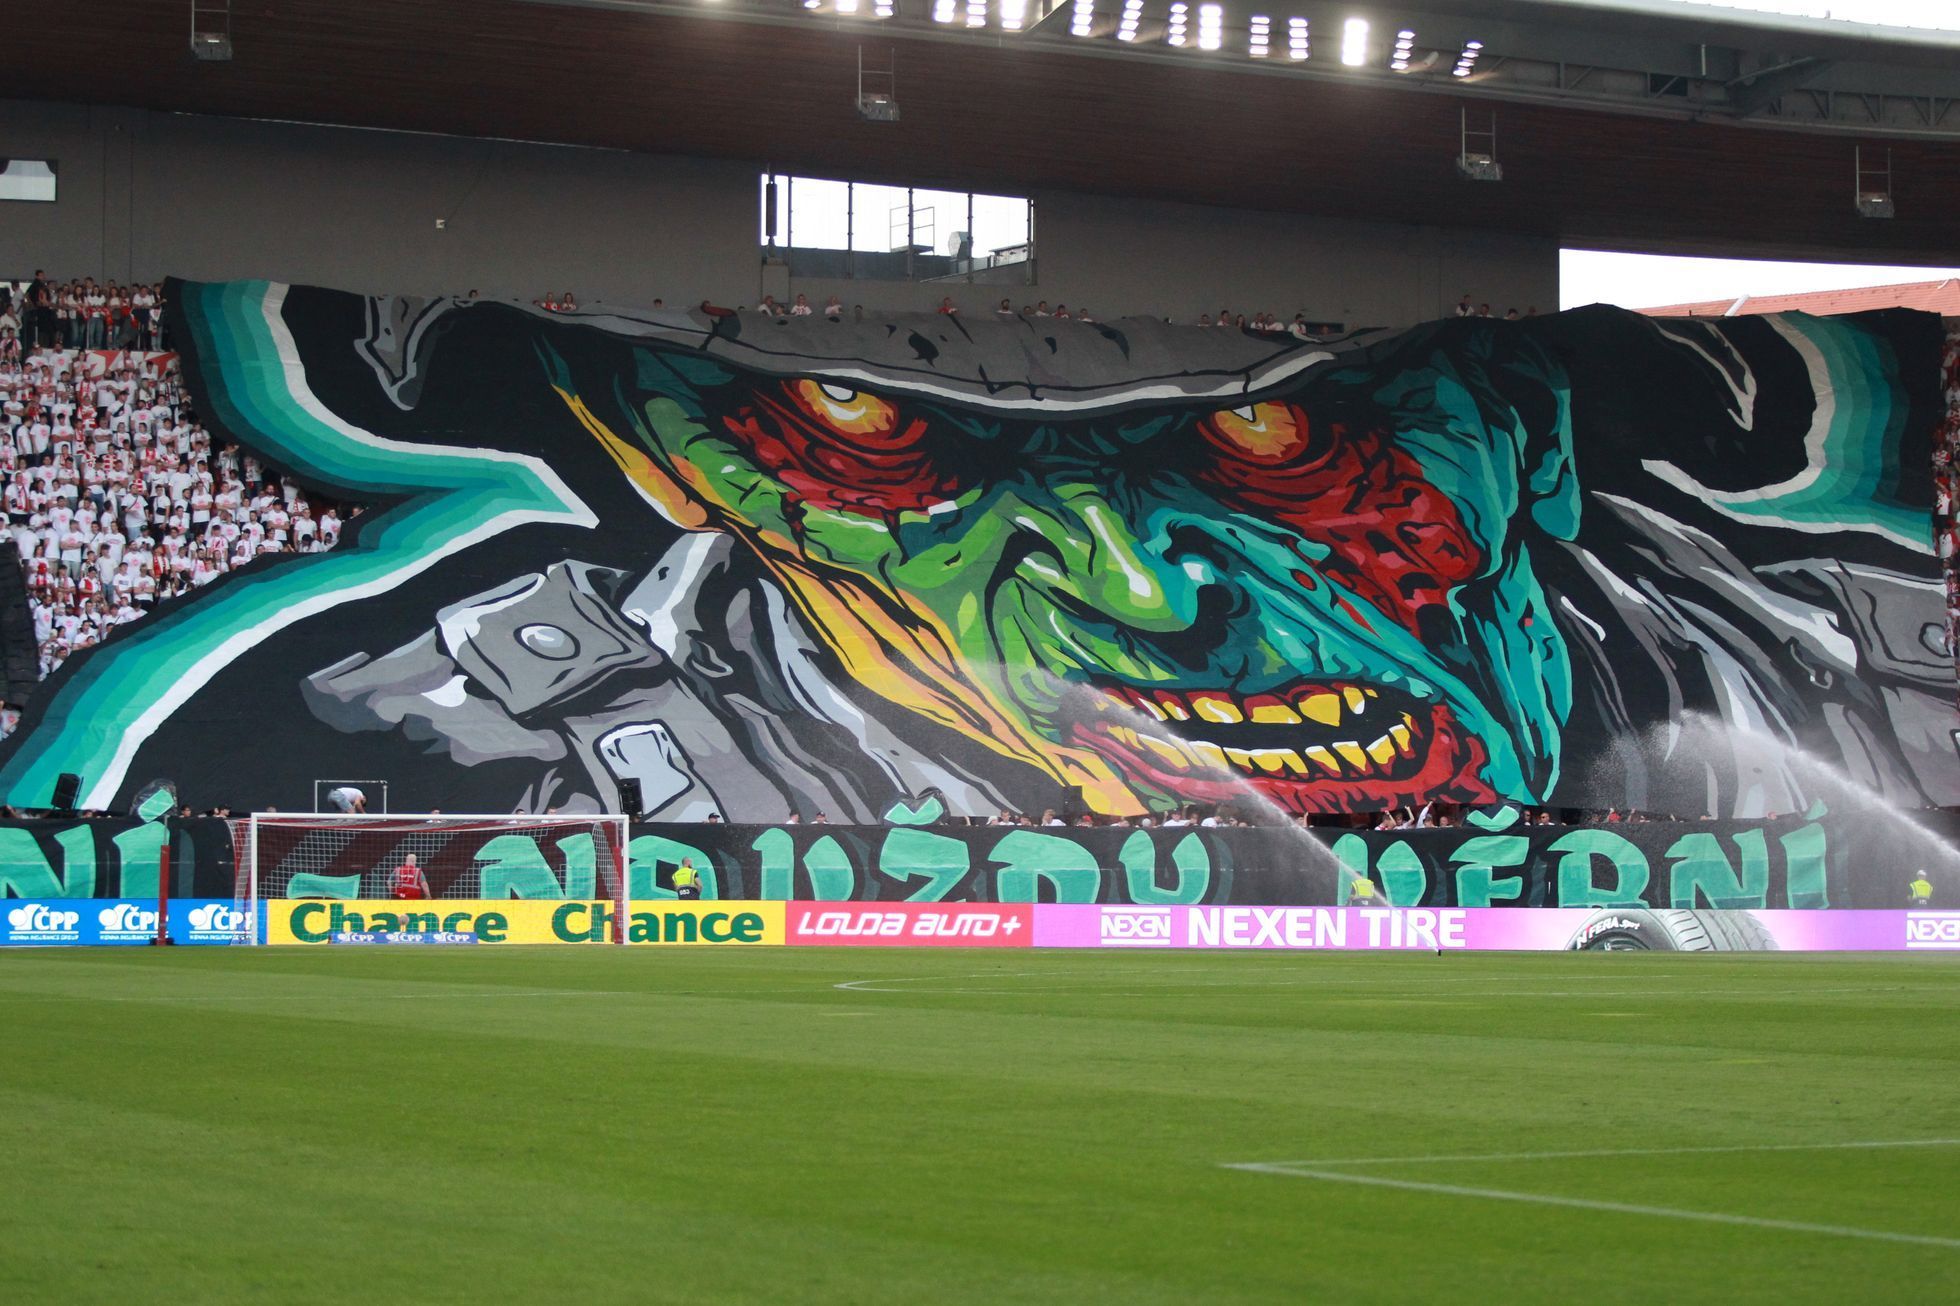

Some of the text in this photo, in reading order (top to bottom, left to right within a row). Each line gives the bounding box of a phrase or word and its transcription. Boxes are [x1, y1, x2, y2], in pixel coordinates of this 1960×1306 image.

[34, 906, 79, 930] ČPP
[290, 902, 508, 943] Chance
[552, 903, 765, 943] Chance
[1101, 915, 1171, 938] NEXEN
[1188, 908, 1467, 948] NEXEN TIRE
